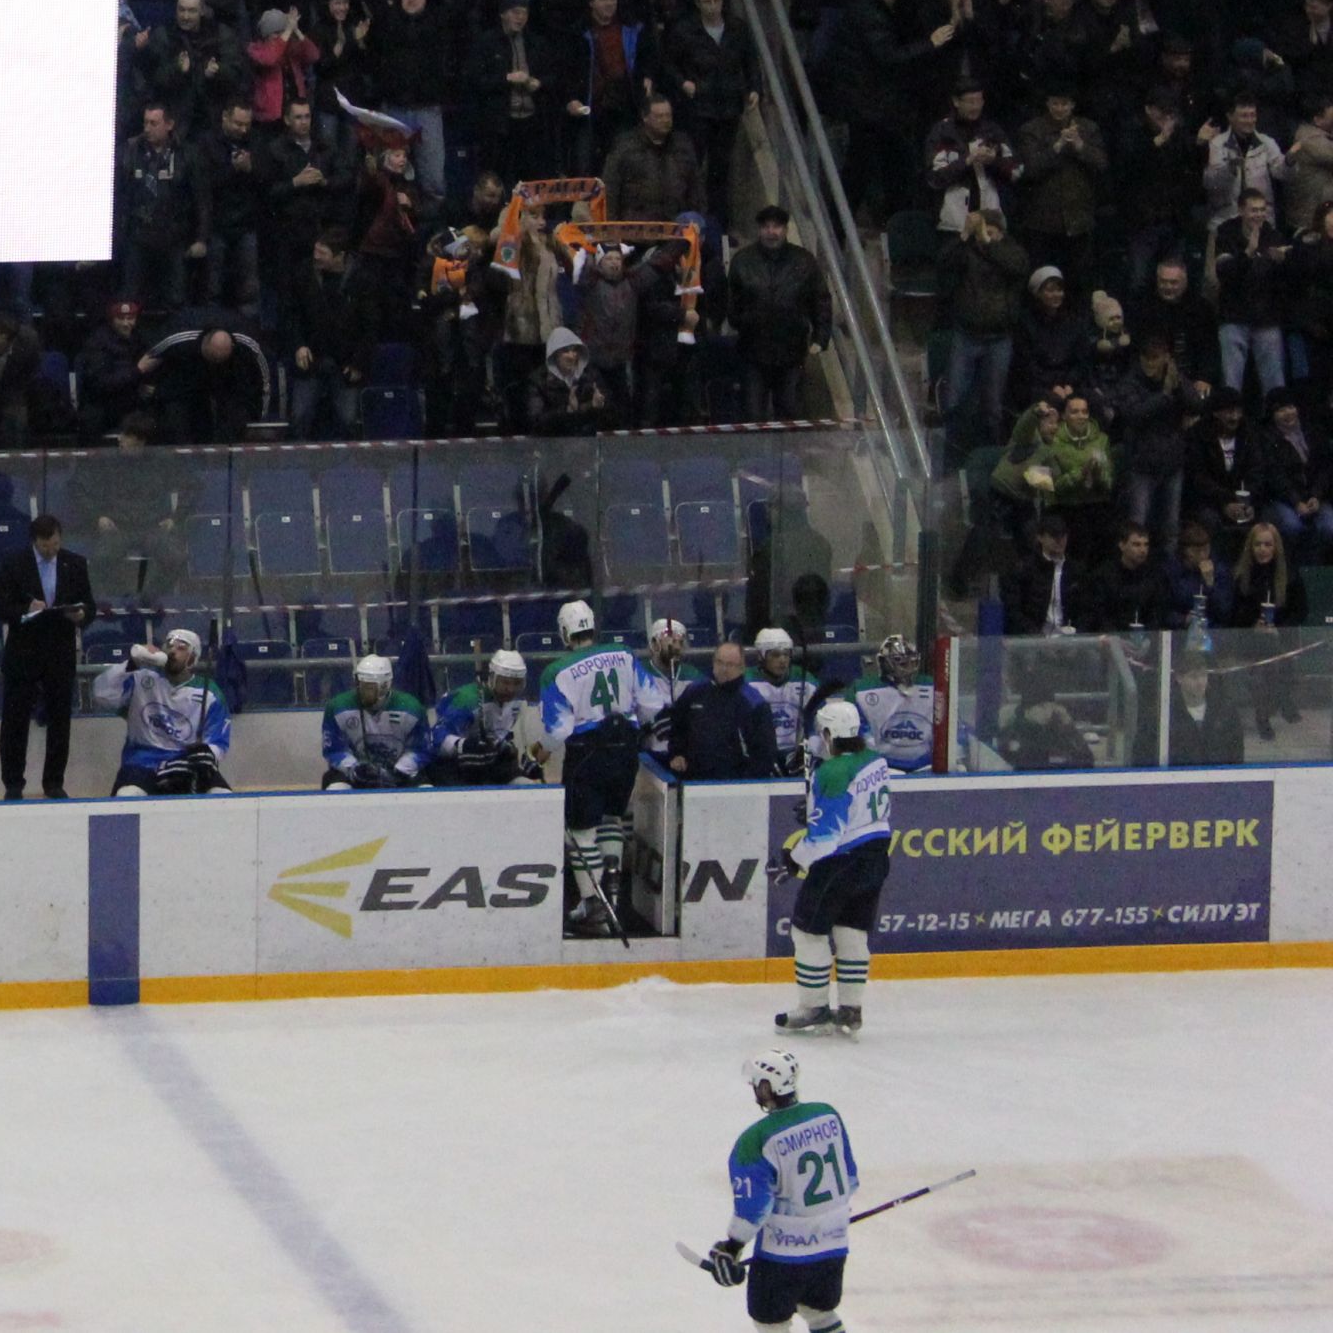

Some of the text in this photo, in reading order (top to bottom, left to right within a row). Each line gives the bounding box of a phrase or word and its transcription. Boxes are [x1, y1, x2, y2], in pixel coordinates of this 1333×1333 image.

[578, 619, 589, 628] 41
[570, 653, 626, 681] ДОРОНИН
[590, 668, 620, 714] 41
[1041, 818, 1260, 856] ФЕЙЕРВЕРК
[359, 863, 564, 913] EAS
[682, 858, 760, 903] N
[990, 910, 1052, 929] МЕГА
[1061, 906, 1149, 926] 677-155
[1166, 902, 1262, 923] СИЛУЭТ
[776, 1120, 839, 1157] СМИРНОВ
[733, 1177, 752, 1199] 21
[797, 1142, 845, 1207] 21
[774, 1232, 819, 1247] УРАЛ
